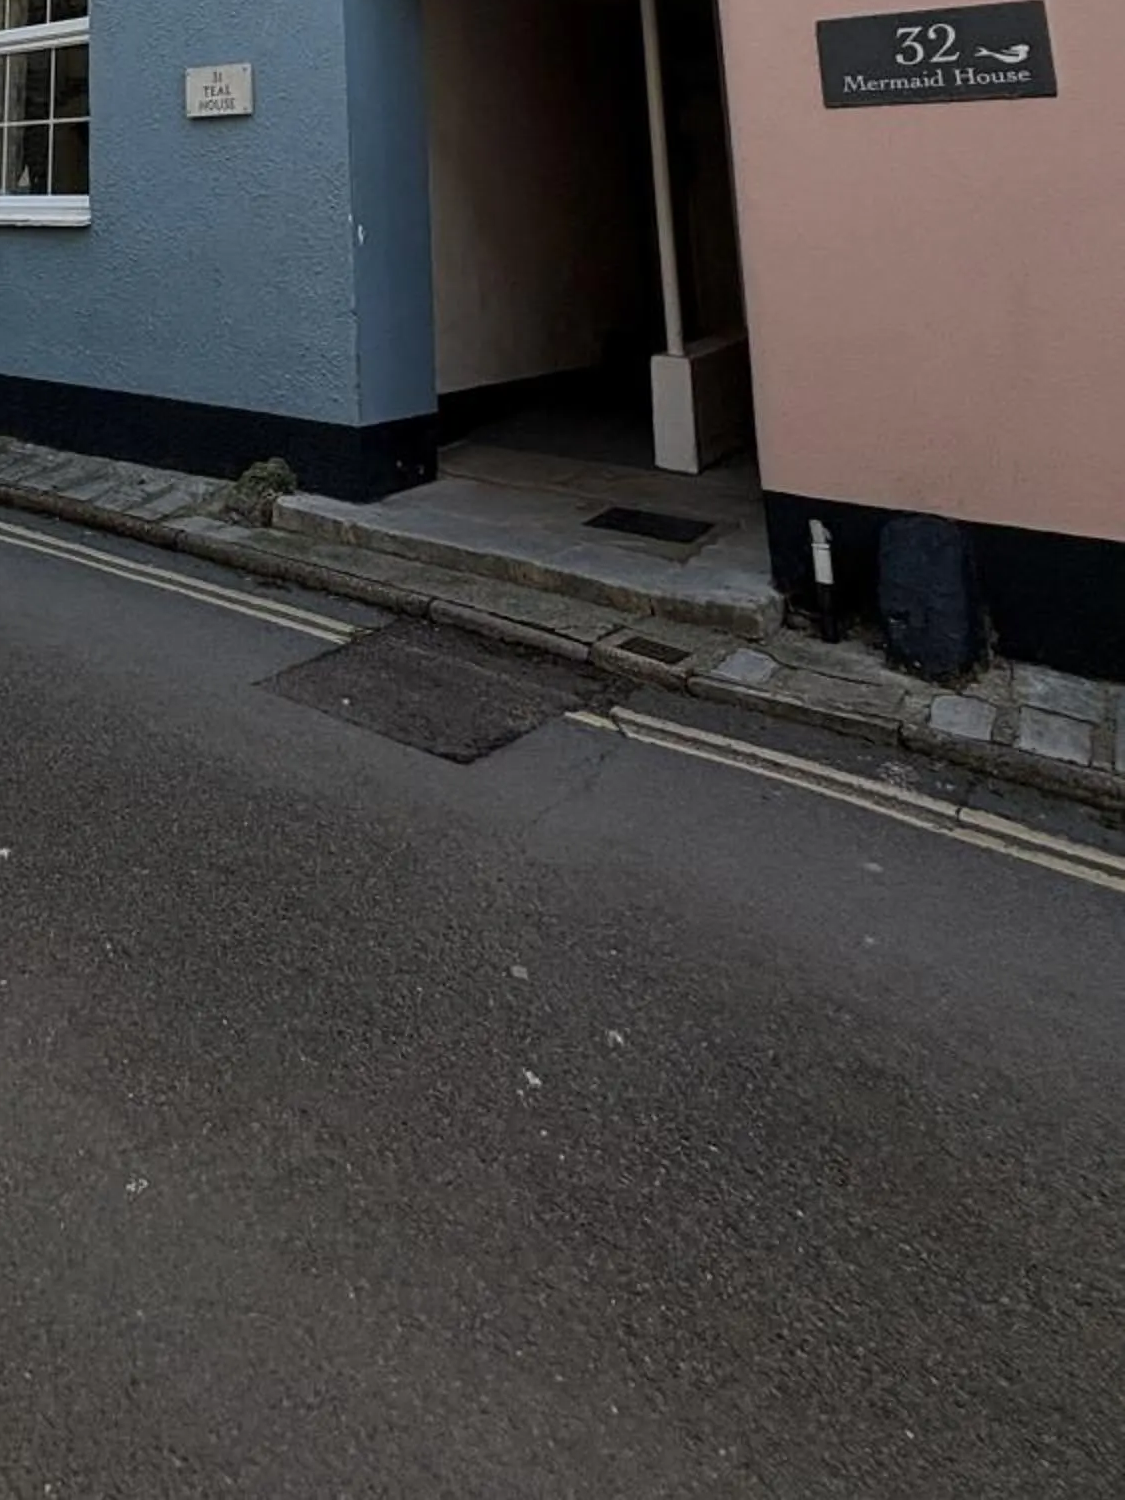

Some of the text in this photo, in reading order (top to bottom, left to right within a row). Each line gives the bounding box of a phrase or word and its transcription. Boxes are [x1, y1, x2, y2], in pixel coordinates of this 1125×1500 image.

[895, 23, 960, 66] 32
[843, 67, 1032, 92] Mermaid House
[203, 84, 232, 97] TEAL
[198, 97, 236, 111] HOUSE
